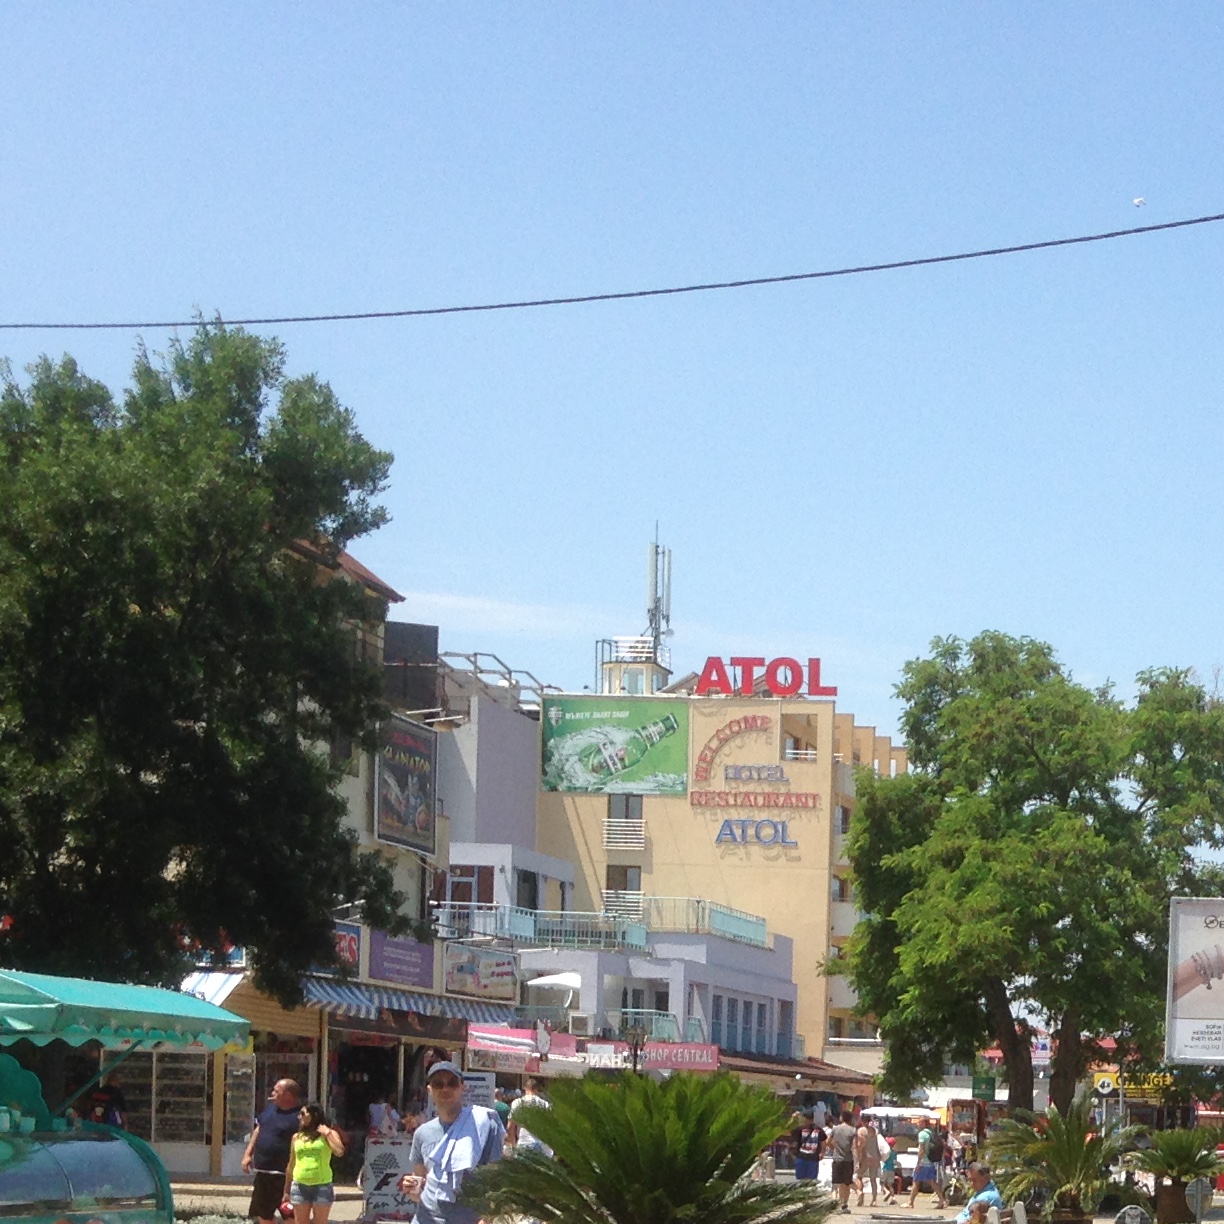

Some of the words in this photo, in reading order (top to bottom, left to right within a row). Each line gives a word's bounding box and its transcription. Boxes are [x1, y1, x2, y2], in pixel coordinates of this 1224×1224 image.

[694, 656, 838, 697] ATOL
[695, 714, 772, 782] WELCOME
[724, 764, 789, 783] HOTEL
[690, 790, 822, 809] RESTAURANT
[715, 818, 798, 847] ATOL
[672, 1048, 714, 1064] CENTRAL
